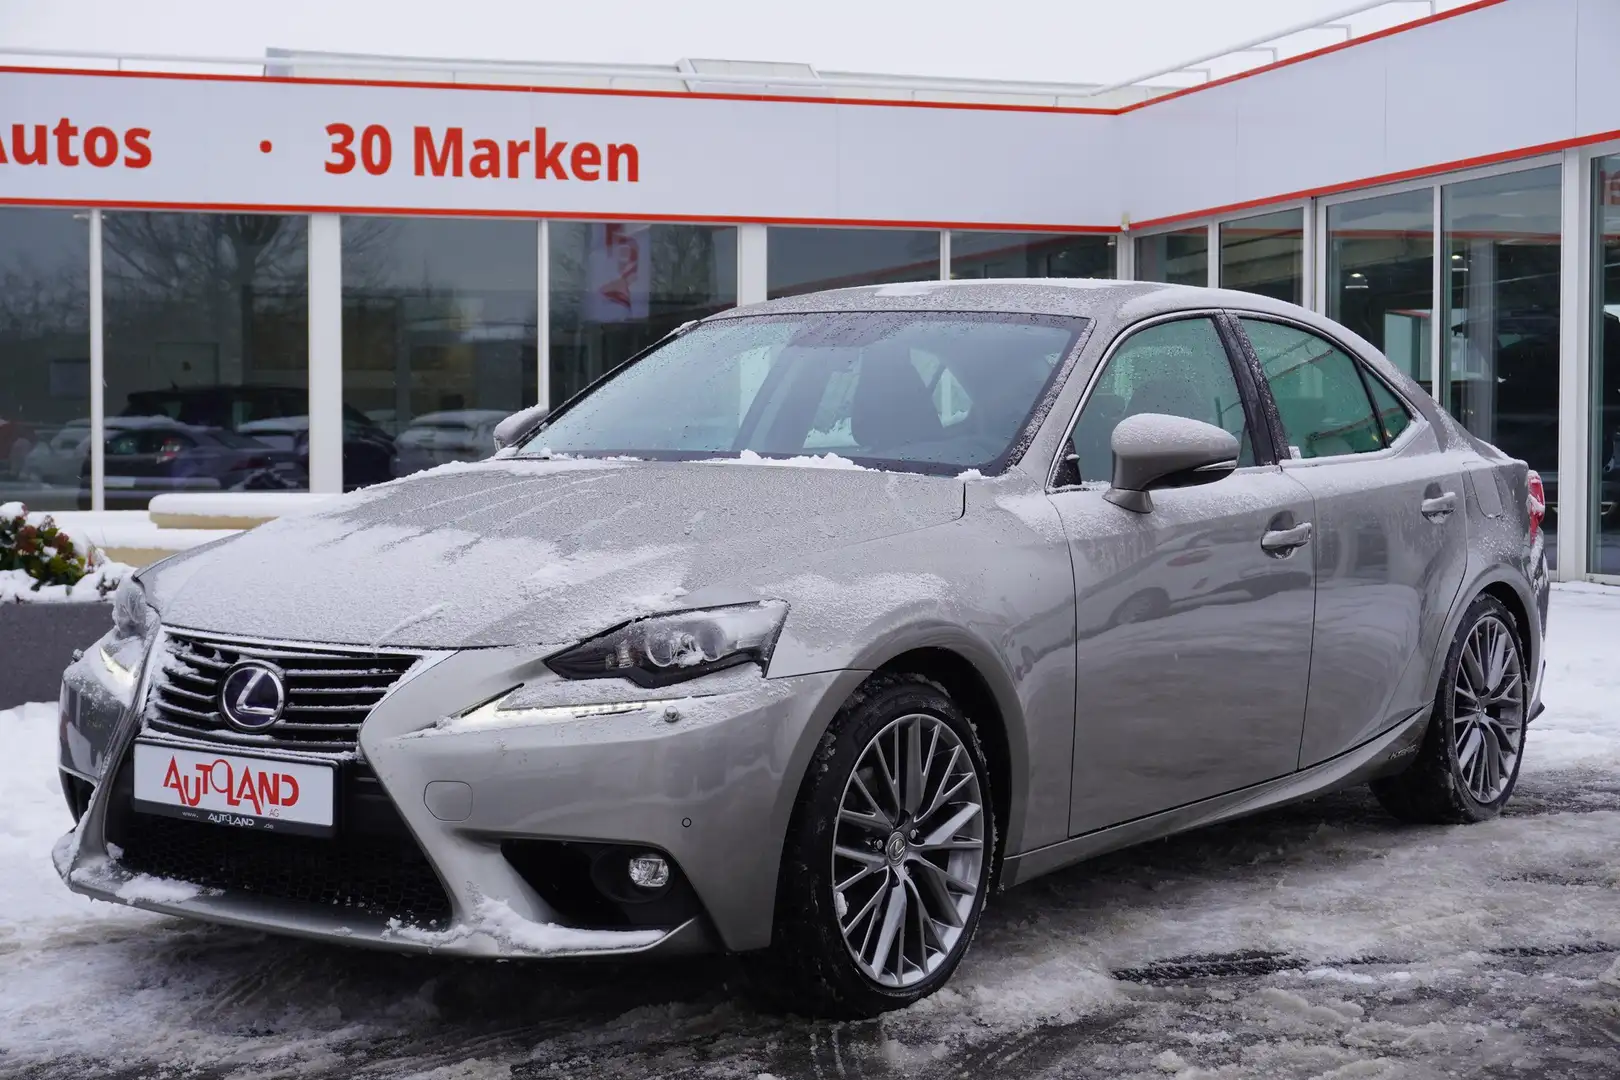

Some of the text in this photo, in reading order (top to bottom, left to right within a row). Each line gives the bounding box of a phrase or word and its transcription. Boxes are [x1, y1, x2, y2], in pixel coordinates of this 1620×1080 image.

[0, 117, 640, 182] utos 30 Marken
[268, 808, 280, 818] AG
